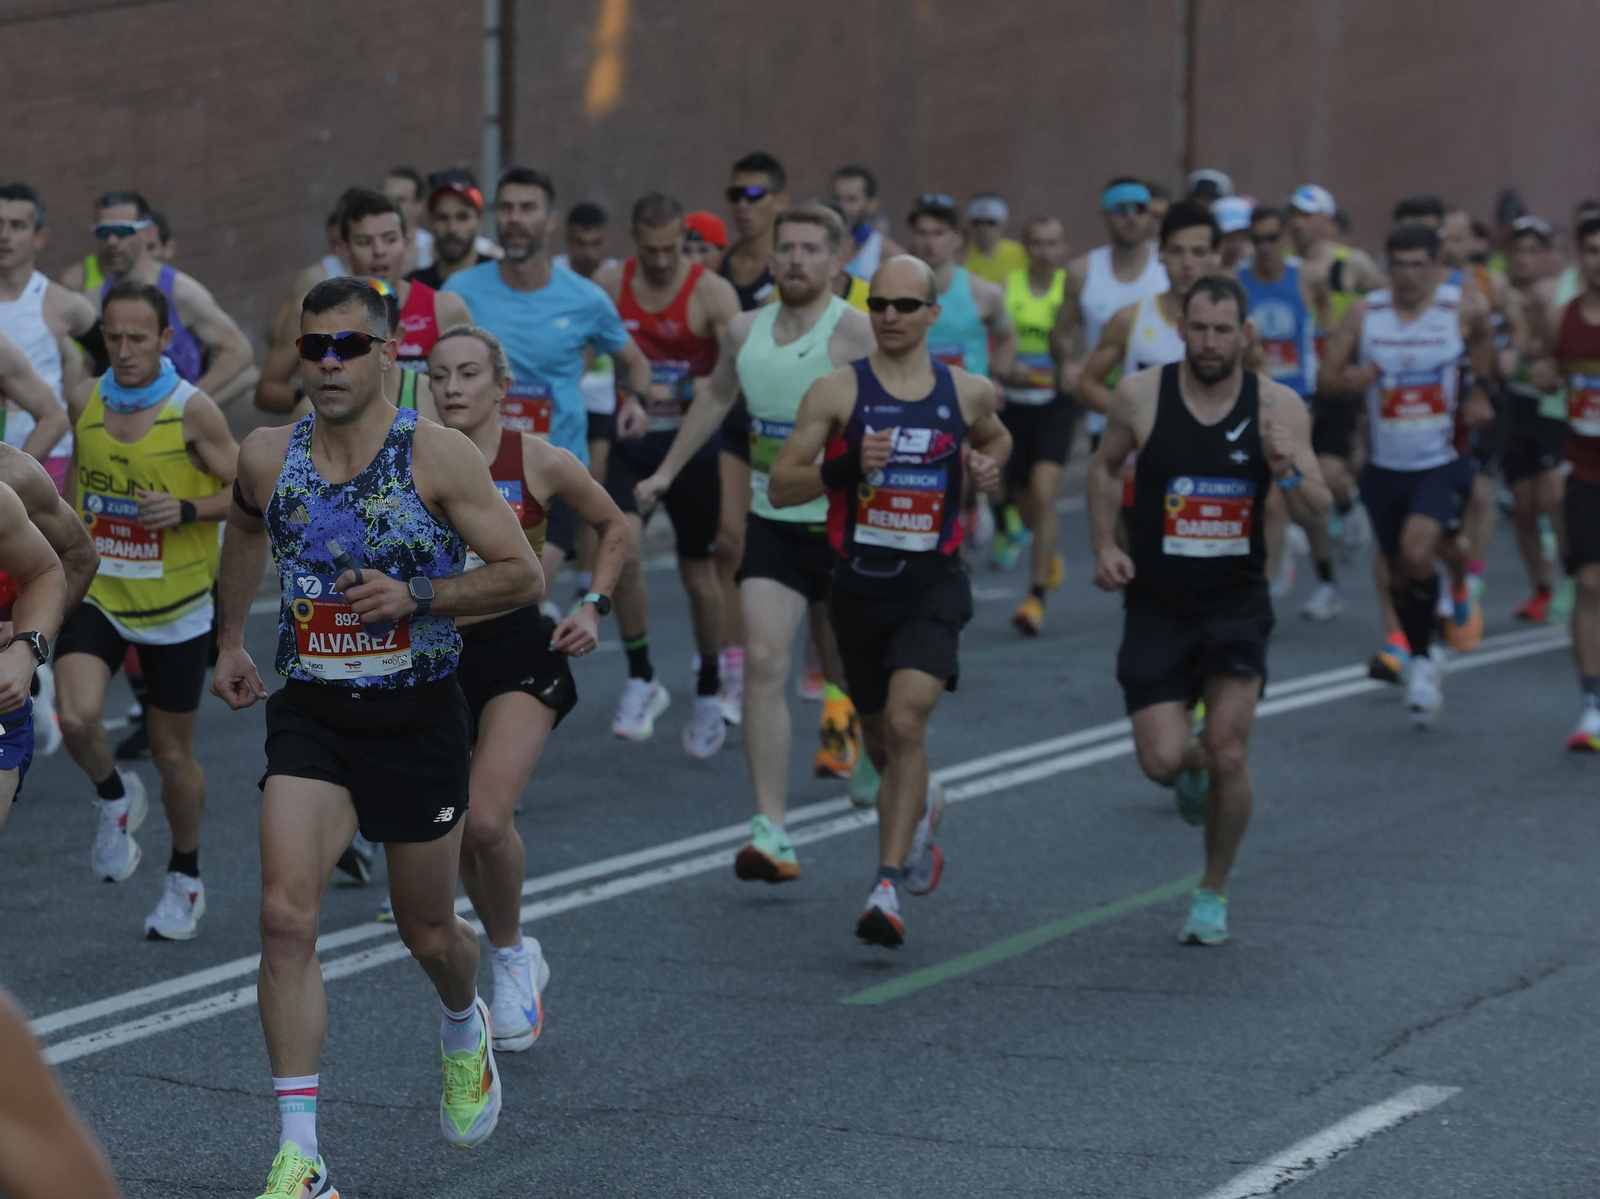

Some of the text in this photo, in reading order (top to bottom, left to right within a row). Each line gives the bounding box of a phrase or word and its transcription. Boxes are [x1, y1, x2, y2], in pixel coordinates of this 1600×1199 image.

[888, 474, 938, 486] ZURICH
[1198, 481, 1247, 495] ZURICH
[867, 509, 933, 531] RENAUD
[1175, 518, 1243, 537] DARREN
[335, 612, 360, 627] 892
[308, 629, 397, 654] ALVAREZ
